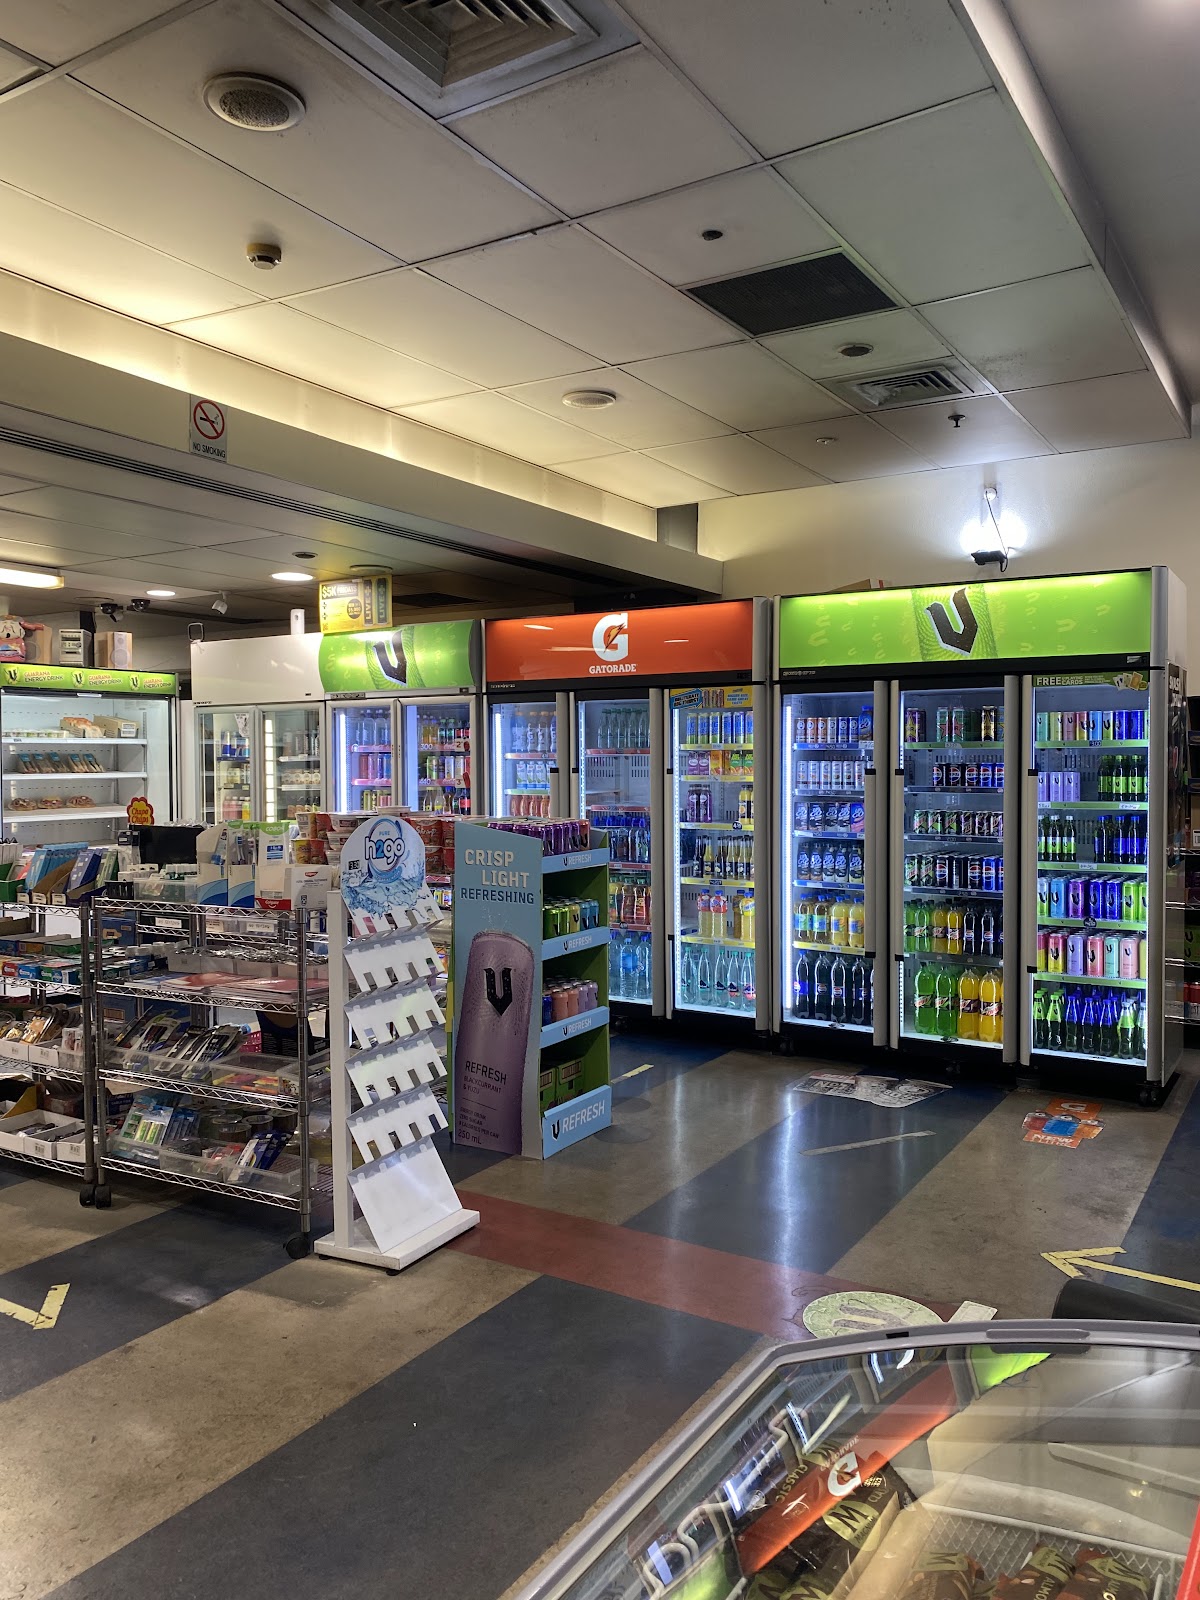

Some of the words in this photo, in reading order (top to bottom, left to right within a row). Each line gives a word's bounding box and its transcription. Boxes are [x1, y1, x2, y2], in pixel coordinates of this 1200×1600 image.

[192, 442, 200, 452] NO
[202, 444, 226, 458] SMOKING
[322, 585, 337, 598] $5K
[924, 588, 979, 656] V
[592, 611, 629, 662] G
[372, 630, 407, 686] V
[588, 663, 637, 675] GATORADE
[1036, 676, 1062, 686] FREE
[364, 836, 406, 865] h2go
[465, 849, 514, 867] CRISP
[568, 853, 592, 865] REFRESH
[482, 870, 530, 888] LIGHT
[461, 888, 534, 904] REFRESHING
[568, 935, 592, 949] REFRESH
[484, 967, 512, 1016] V
[568, 1017, 592, 1034] REFRESH
[465, 1060, 507, 1086] REFRESH
[463, 1075, 502, 1094] BLACKCURRANT
[552, 1119, 560, 1141] V
[562, 1100, 605, 1134] REFRESH
[458, 1129, 470, 1140] 250
[472, 1135, 482, 1144] mL
[775, 1464, 808, 1504] CLASSIC
[828, 1504, 871, 1534] M
[1033, 1576, 1056, 1600] ALMO
